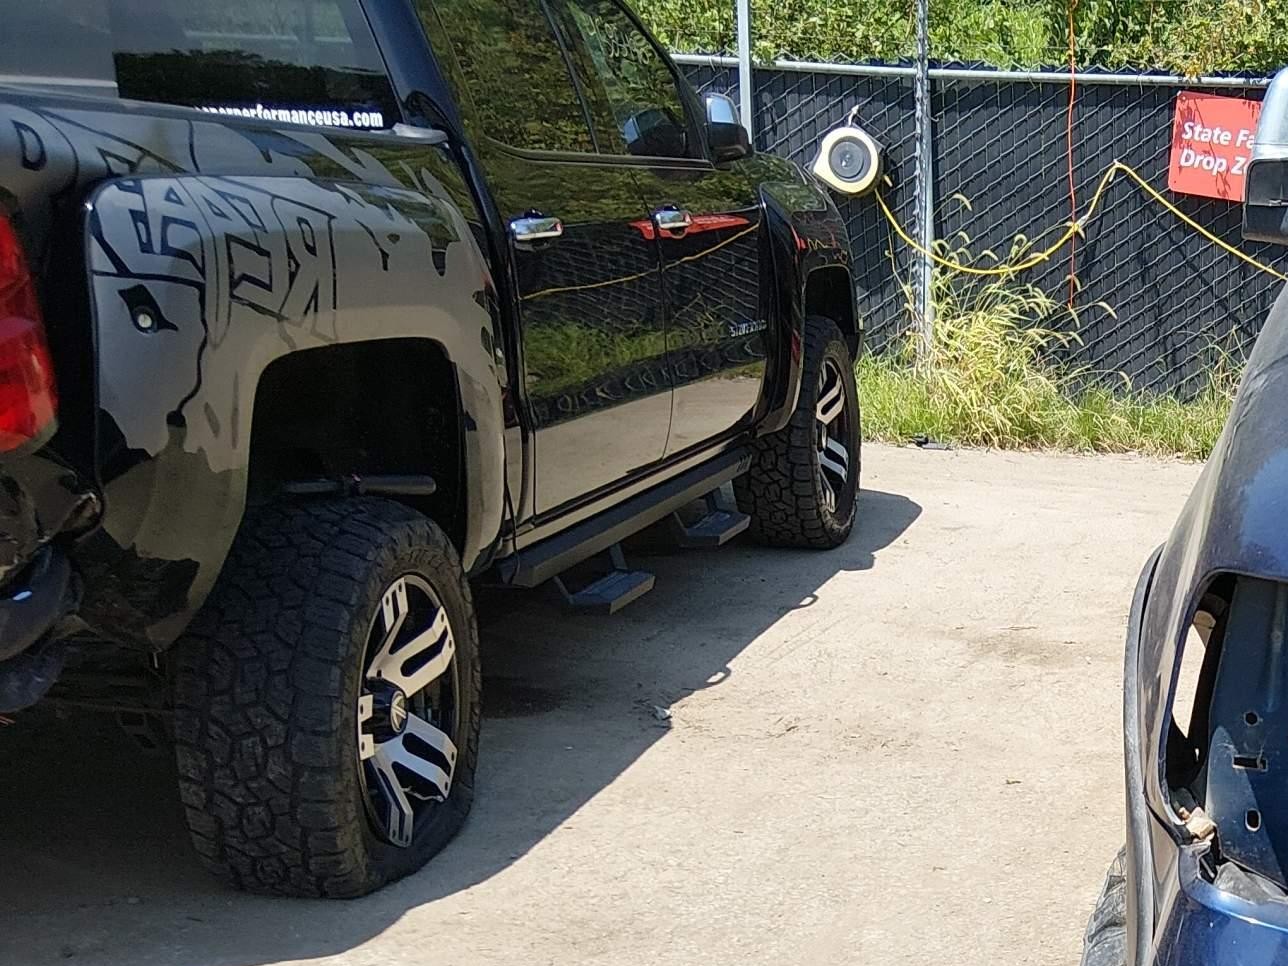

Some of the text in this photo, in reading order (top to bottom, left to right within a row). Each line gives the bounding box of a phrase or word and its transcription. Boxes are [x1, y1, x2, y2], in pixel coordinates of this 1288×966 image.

[1181, 121, 1232, 146] State
[1179, 149, 1248, 176] Drop Z
